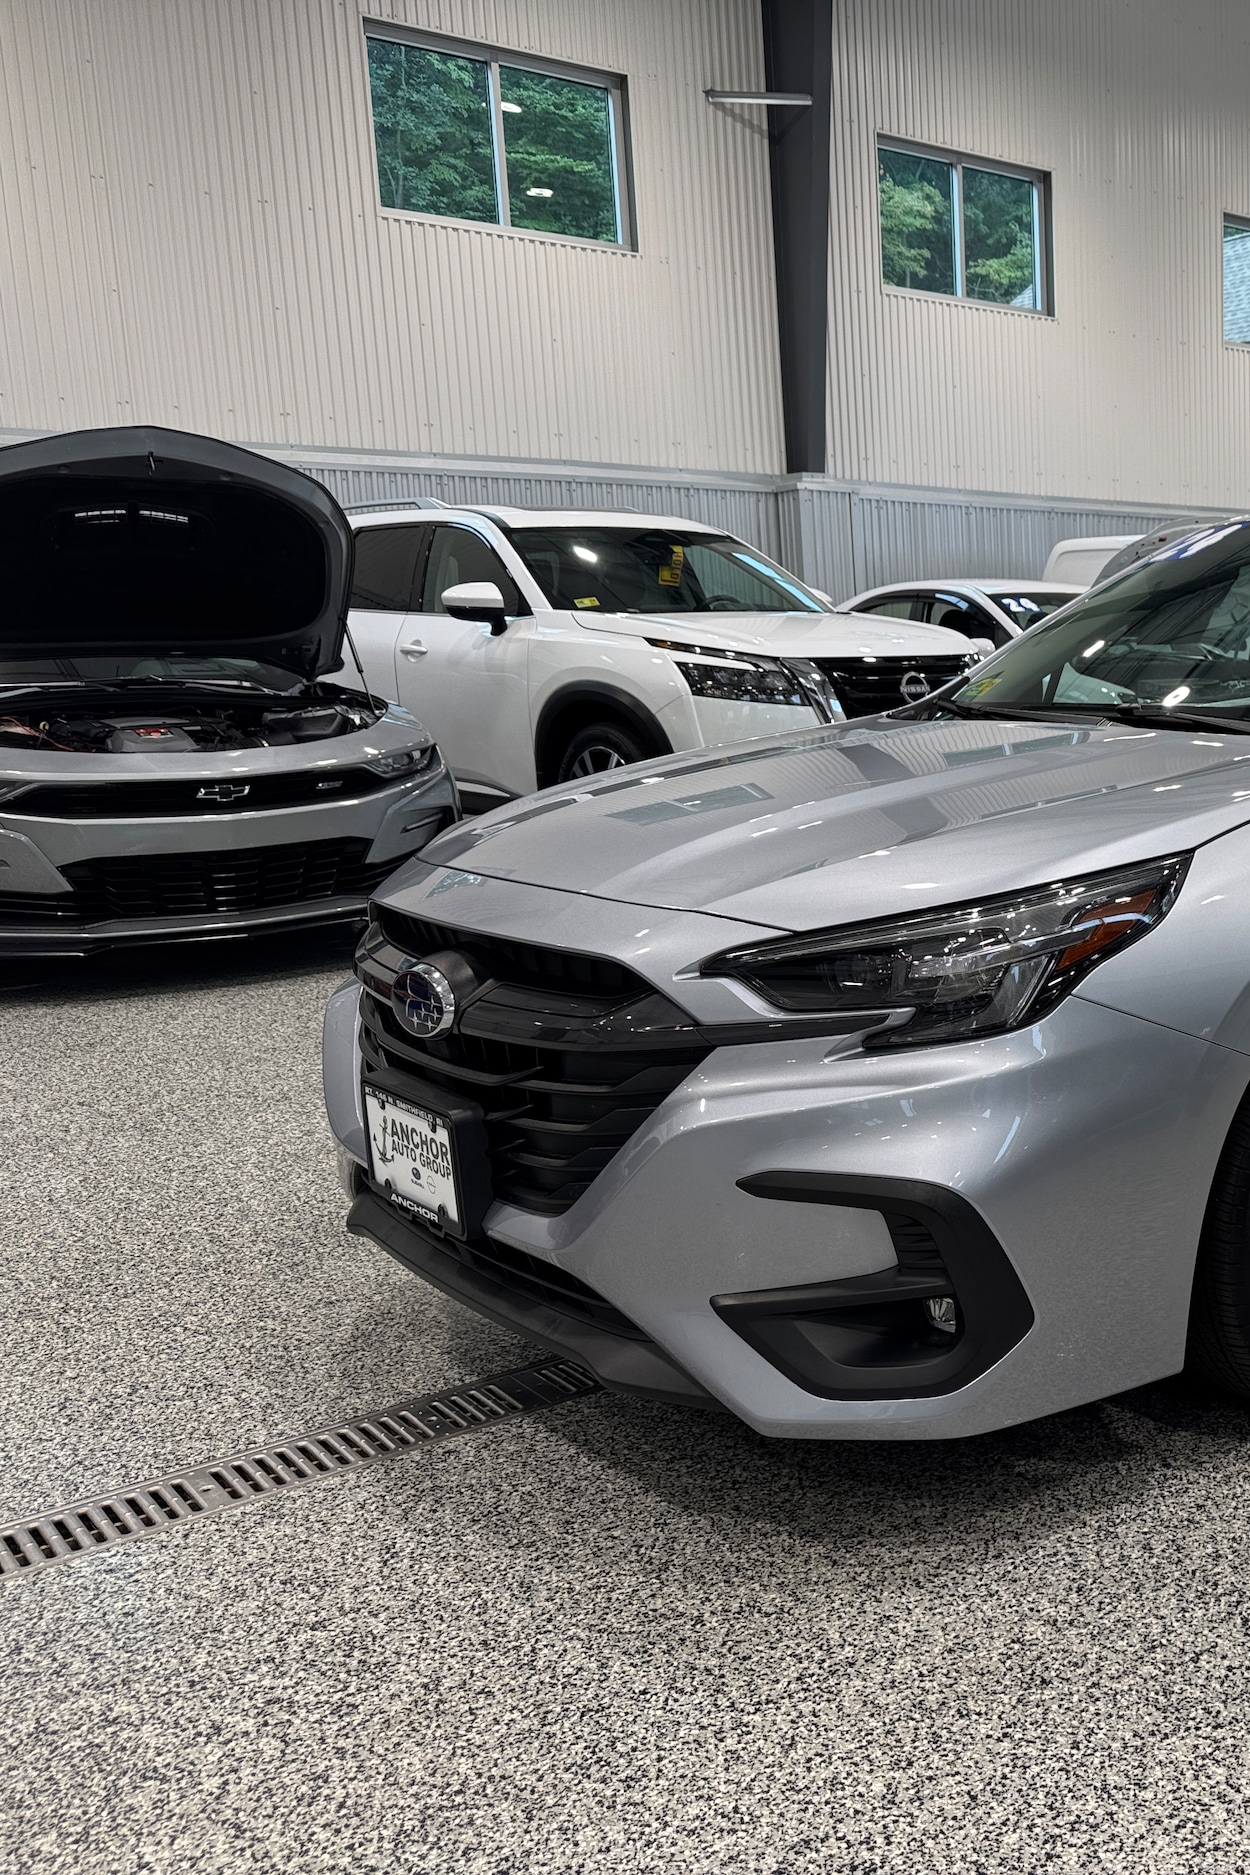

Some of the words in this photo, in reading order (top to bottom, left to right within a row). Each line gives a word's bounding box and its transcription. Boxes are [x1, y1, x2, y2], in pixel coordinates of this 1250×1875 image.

[900, 684, 930, 694] NISSAN
[391, 1118, 451, 1167] ANCHOR
[391, 1138, 417, 1163] AUTO
[419, 1152, 452, 1181] GROUP
[390, 1193, 440, 1223] ANCHOR
